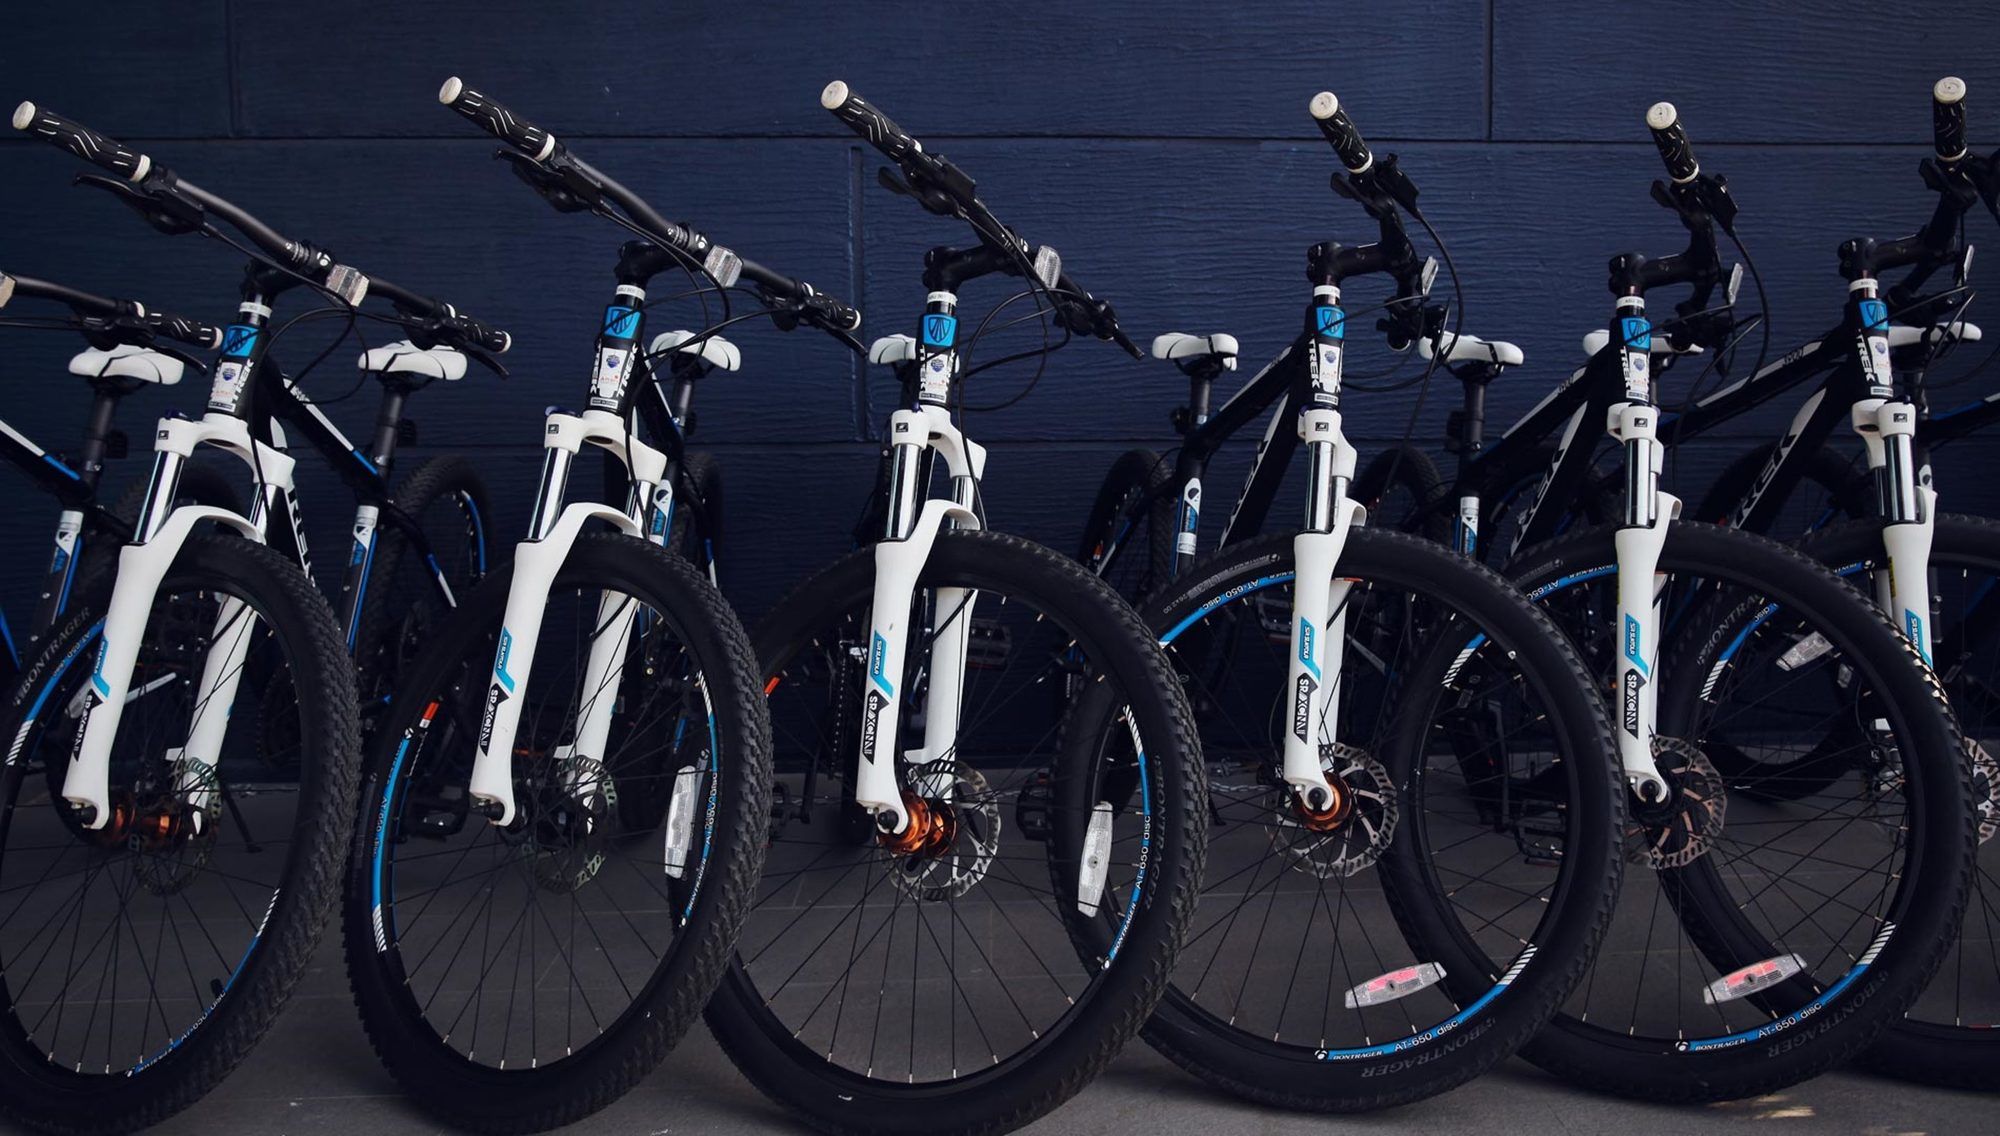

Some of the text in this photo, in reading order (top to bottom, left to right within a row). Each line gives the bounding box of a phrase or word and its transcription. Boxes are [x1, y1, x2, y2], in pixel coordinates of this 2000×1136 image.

[1309, 338, 1320, 392] TREK
[21, 606, 91, 695] BONTRAGER
[1332, 1019, 1459, 1061] BONTRAGER AT-650 disc
[1695, 1001, 1823, 1052] BONTRAGER AT-650 disc
